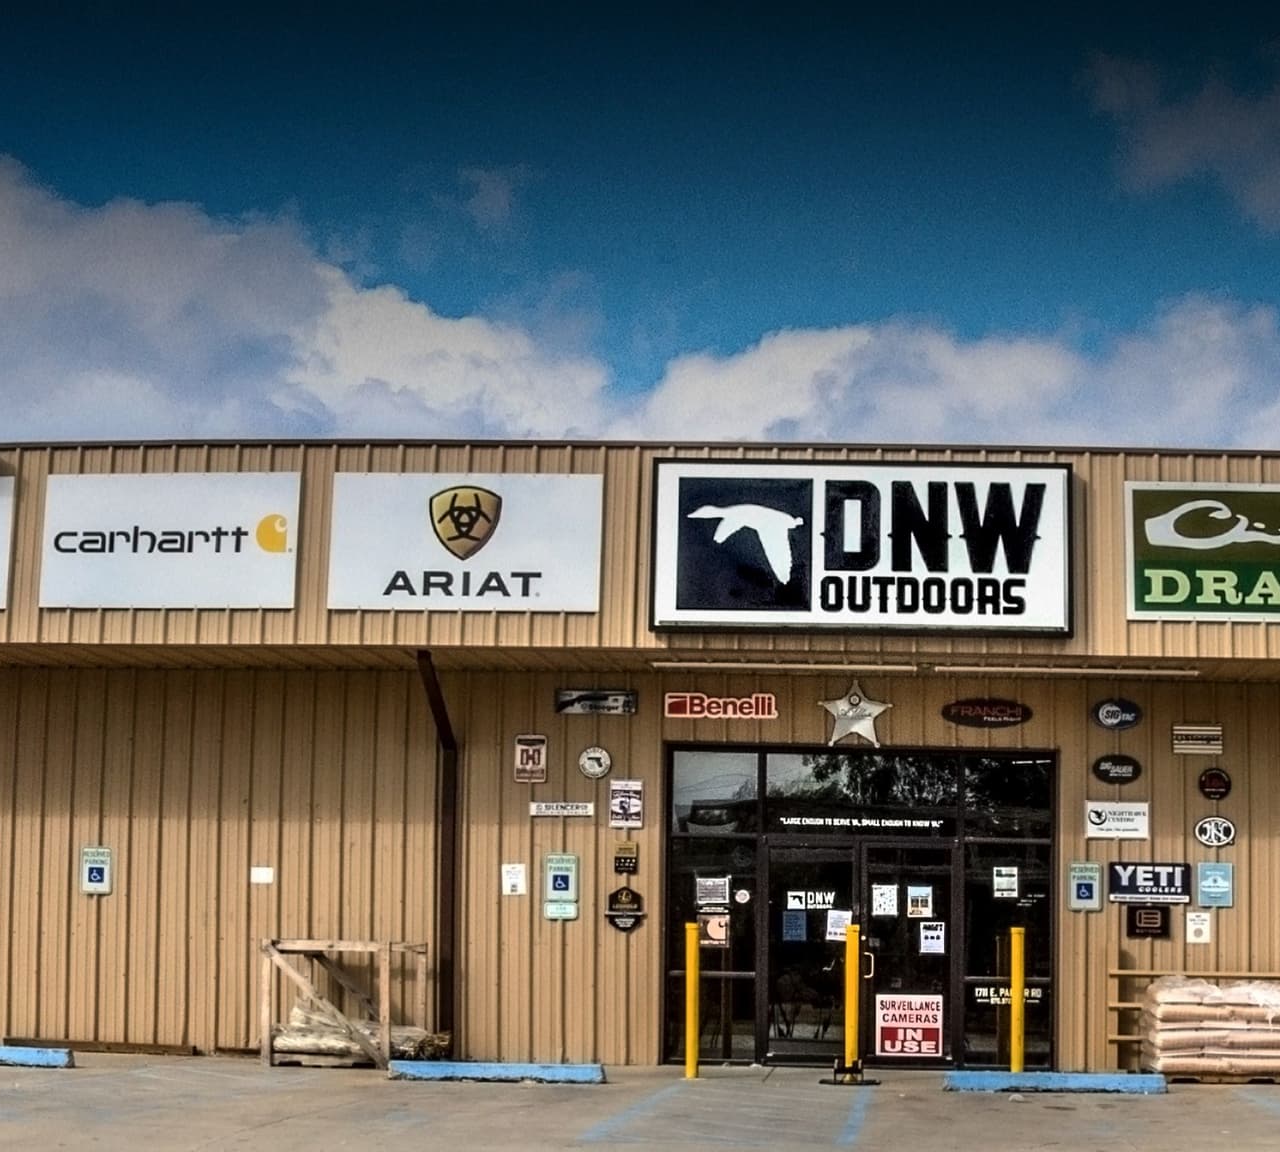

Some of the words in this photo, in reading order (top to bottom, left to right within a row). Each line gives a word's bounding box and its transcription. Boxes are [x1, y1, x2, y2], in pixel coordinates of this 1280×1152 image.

[822, 479, 1048, 574] DNW
[53, 525, 248, 553] carhartt
[382, 570, 542, 597] ARIAT
[820, 575, 1026, 616] OUTDOORS
[688, 694, 774, 718] Benelli
[951, 705, 1023, 717] FRANCHI
[1114, 865, 1184, 887] YETI
[1138, 886, 1183, 894] COOLERS
[807, 891, 836, 904] DNW
[880, 999, 941, 1012] SURVEILLANCE
[882, 1013, 938, 1024] CAMERAS
[897, 1029, 923, 1040] IN
[884, 1041, 937, 1053] USE
